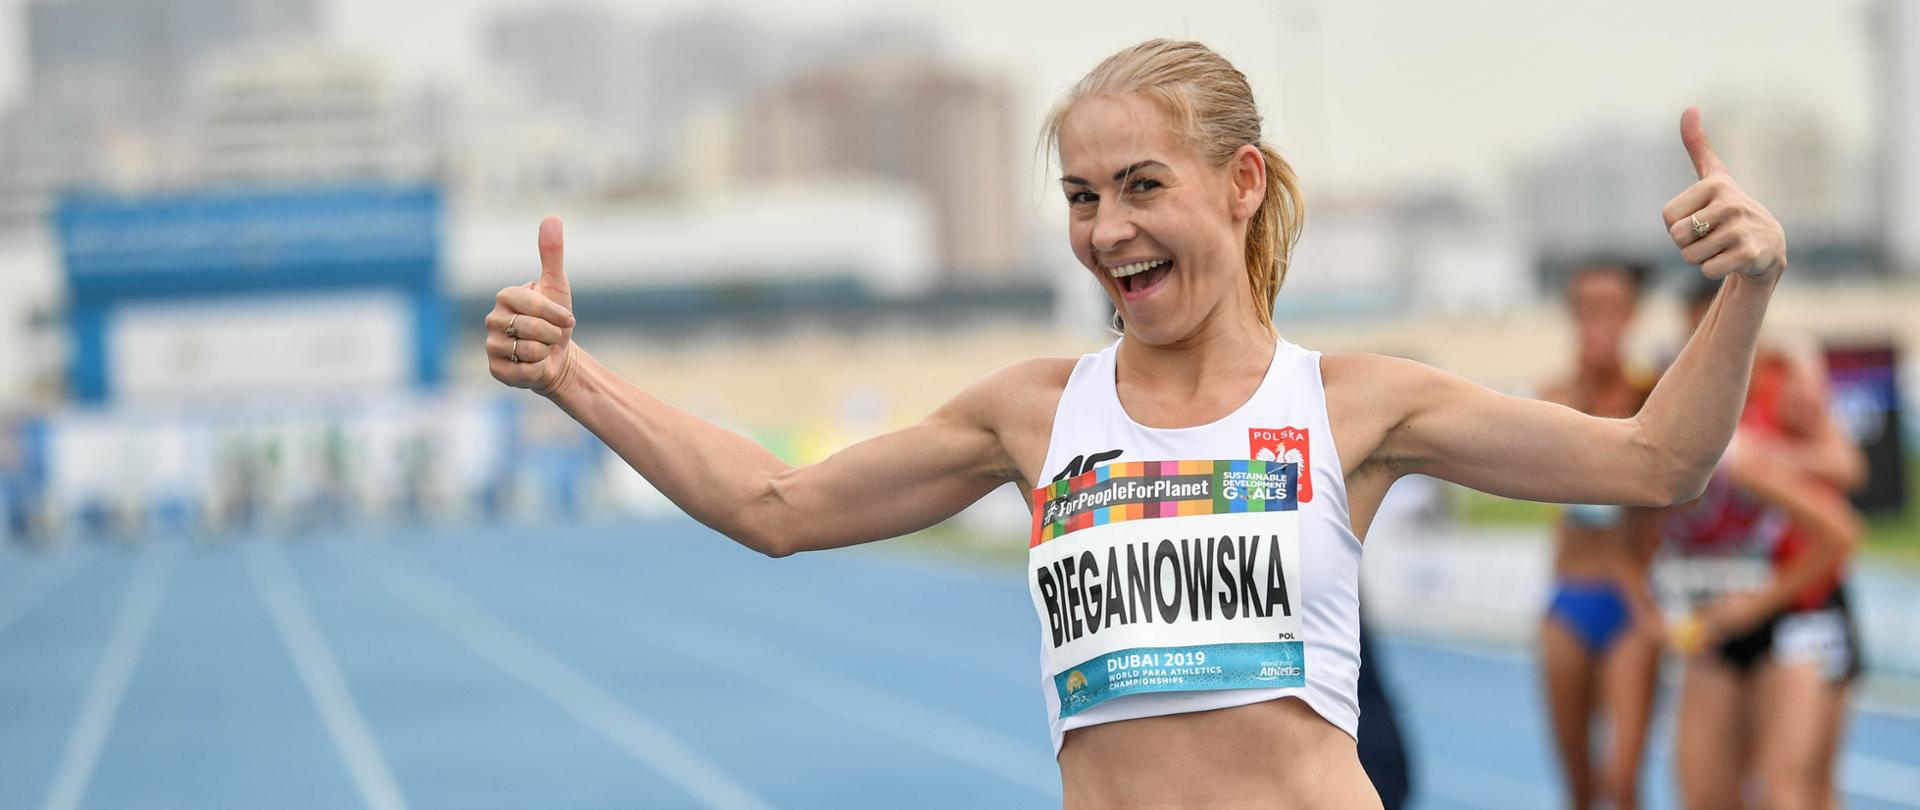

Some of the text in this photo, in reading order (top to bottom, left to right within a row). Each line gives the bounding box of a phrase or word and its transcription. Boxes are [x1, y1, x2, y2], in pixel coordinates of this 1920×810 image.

[1253, 430, 1304, 441] POLSKA
[1223, 471, 1288, 482] SUSTAINABLE
[1223, 479, 1287, 489] DEVELOPMENT
[1044, 480, 1209, 525] #ForPeopleForPlanet
[1037, 535, 1292, 648] BIEGANOWSKA
[1279, 632, 1295, 640] POL
[1107, 651, 1205, 672] DUBAI 2019
[1108, 666, 1222, 682] WORLD PARA ATHLETICS
[1109, 676, 1184, 690] CHAMPIONSHIPS
